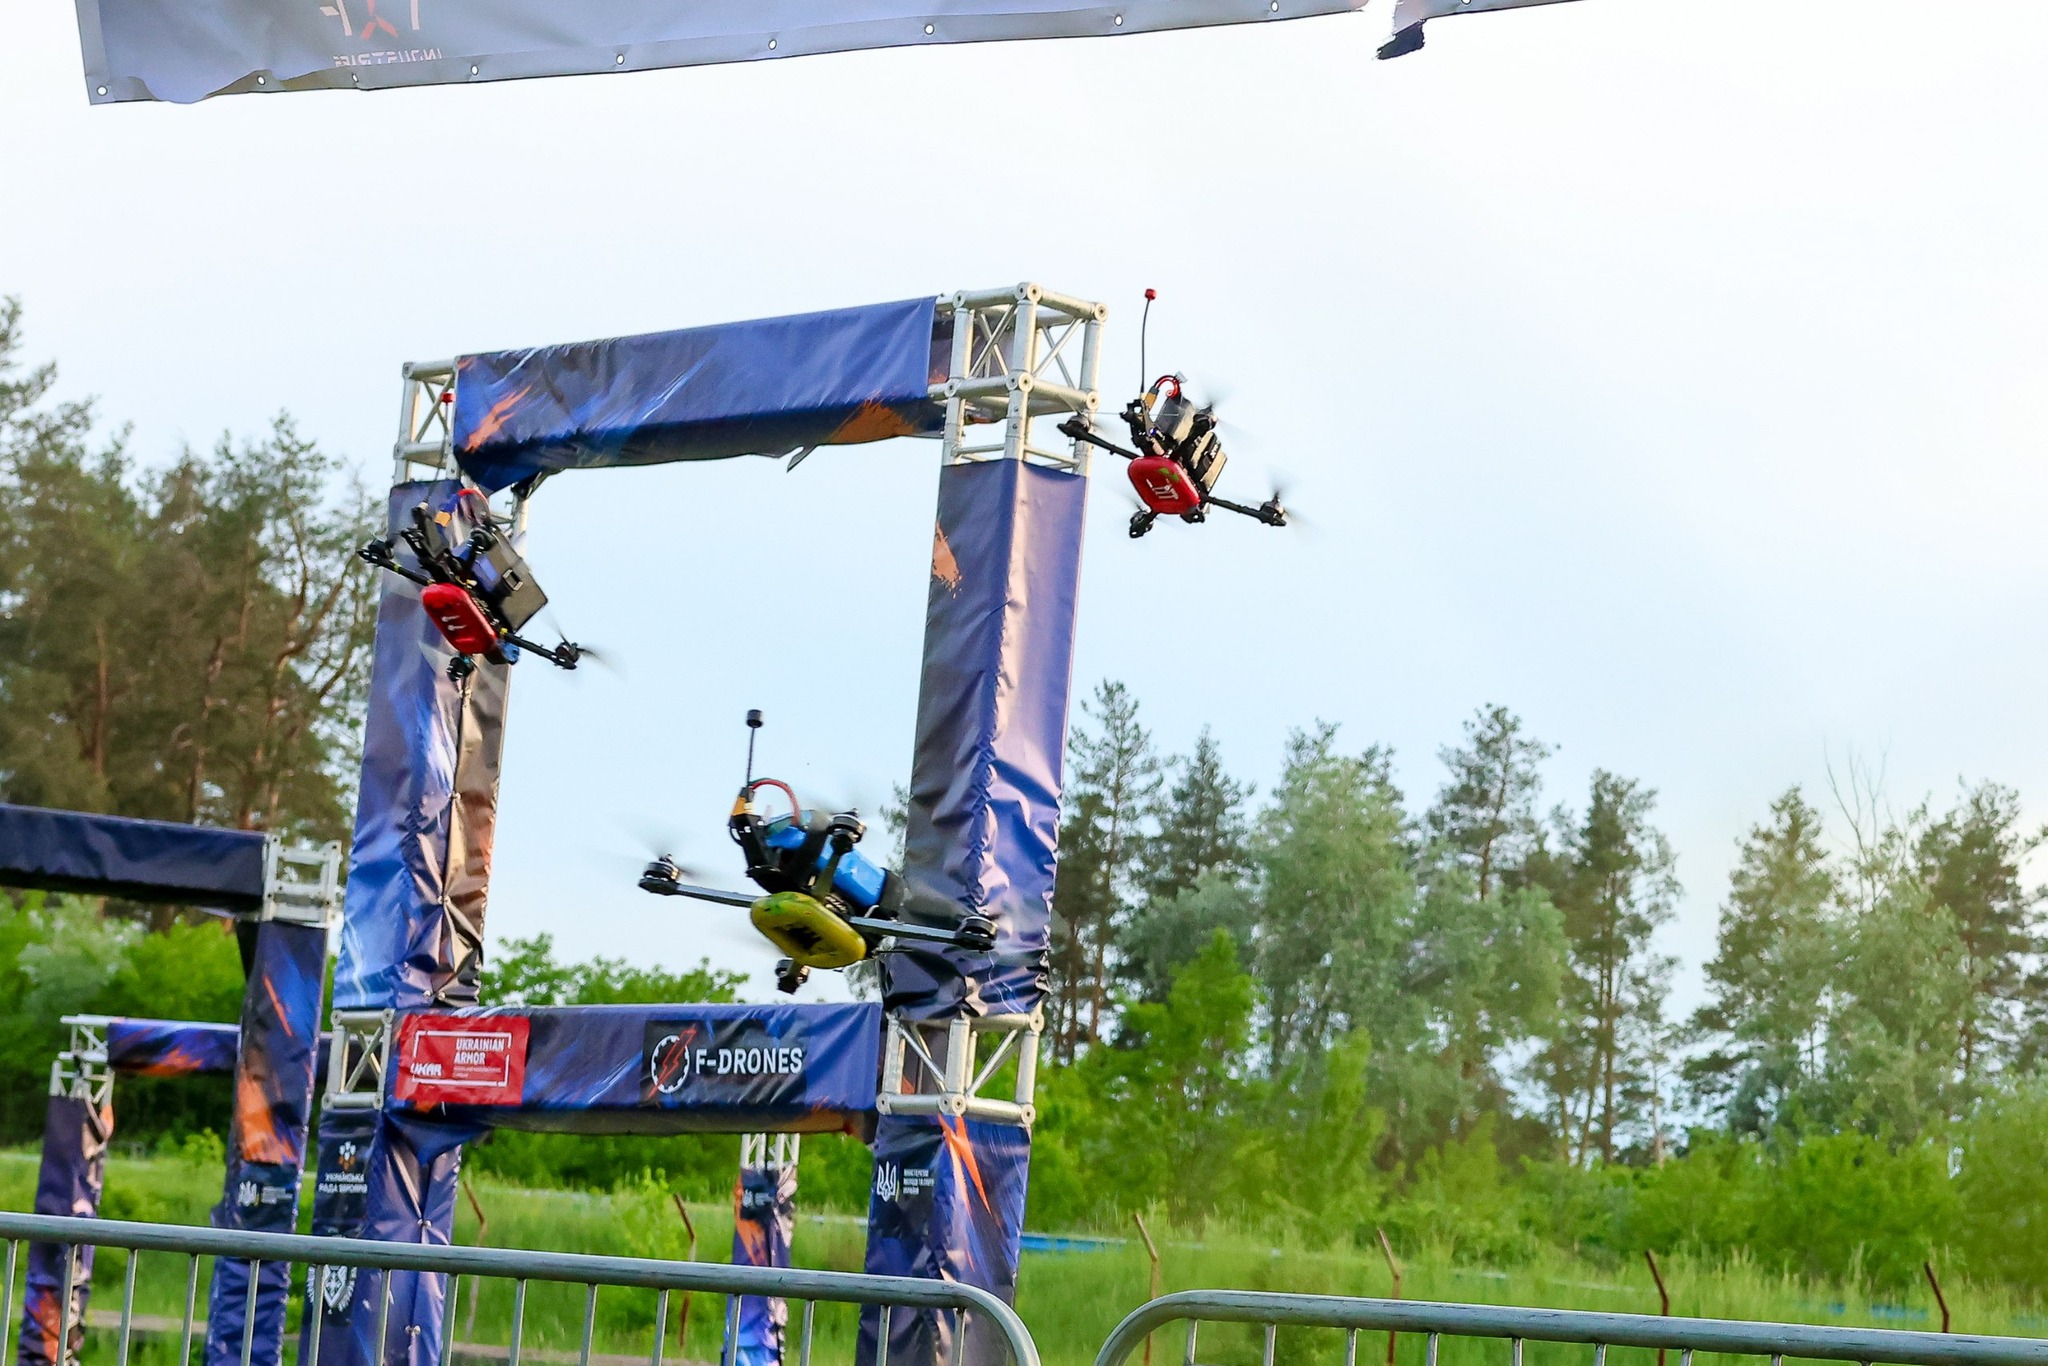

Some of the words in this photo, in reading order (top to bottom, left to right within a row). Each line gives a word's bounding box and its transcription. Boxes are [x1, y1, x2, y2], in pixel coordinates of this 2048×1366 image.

[455, 1037, 505, 1052] UKRAINIAN
[453, 1051, 486, 1066] ARMOR
[695, 1047, 803, 1075] F-DRONES
